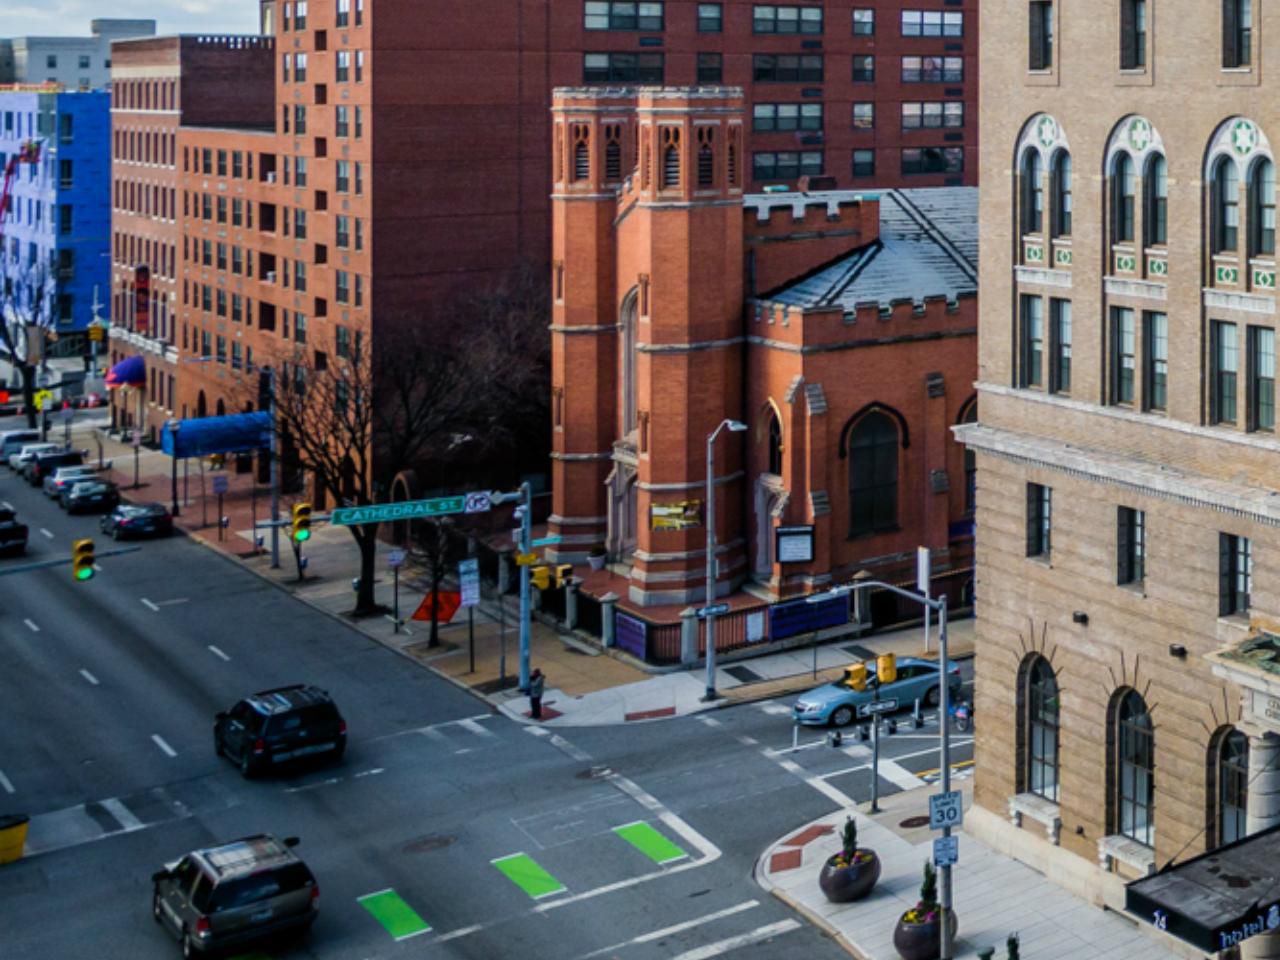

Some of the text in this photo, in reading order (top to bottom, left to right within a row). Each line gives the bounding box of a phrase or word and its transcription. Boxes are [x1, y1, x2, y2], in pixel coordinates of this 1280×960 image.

[341, 503, 434, 522] CATHEDRAL
[936, 806, 957, 823] 30
[1153, 909, 1168, 930] 24
[1220, 916, 1265, 948] hotel
